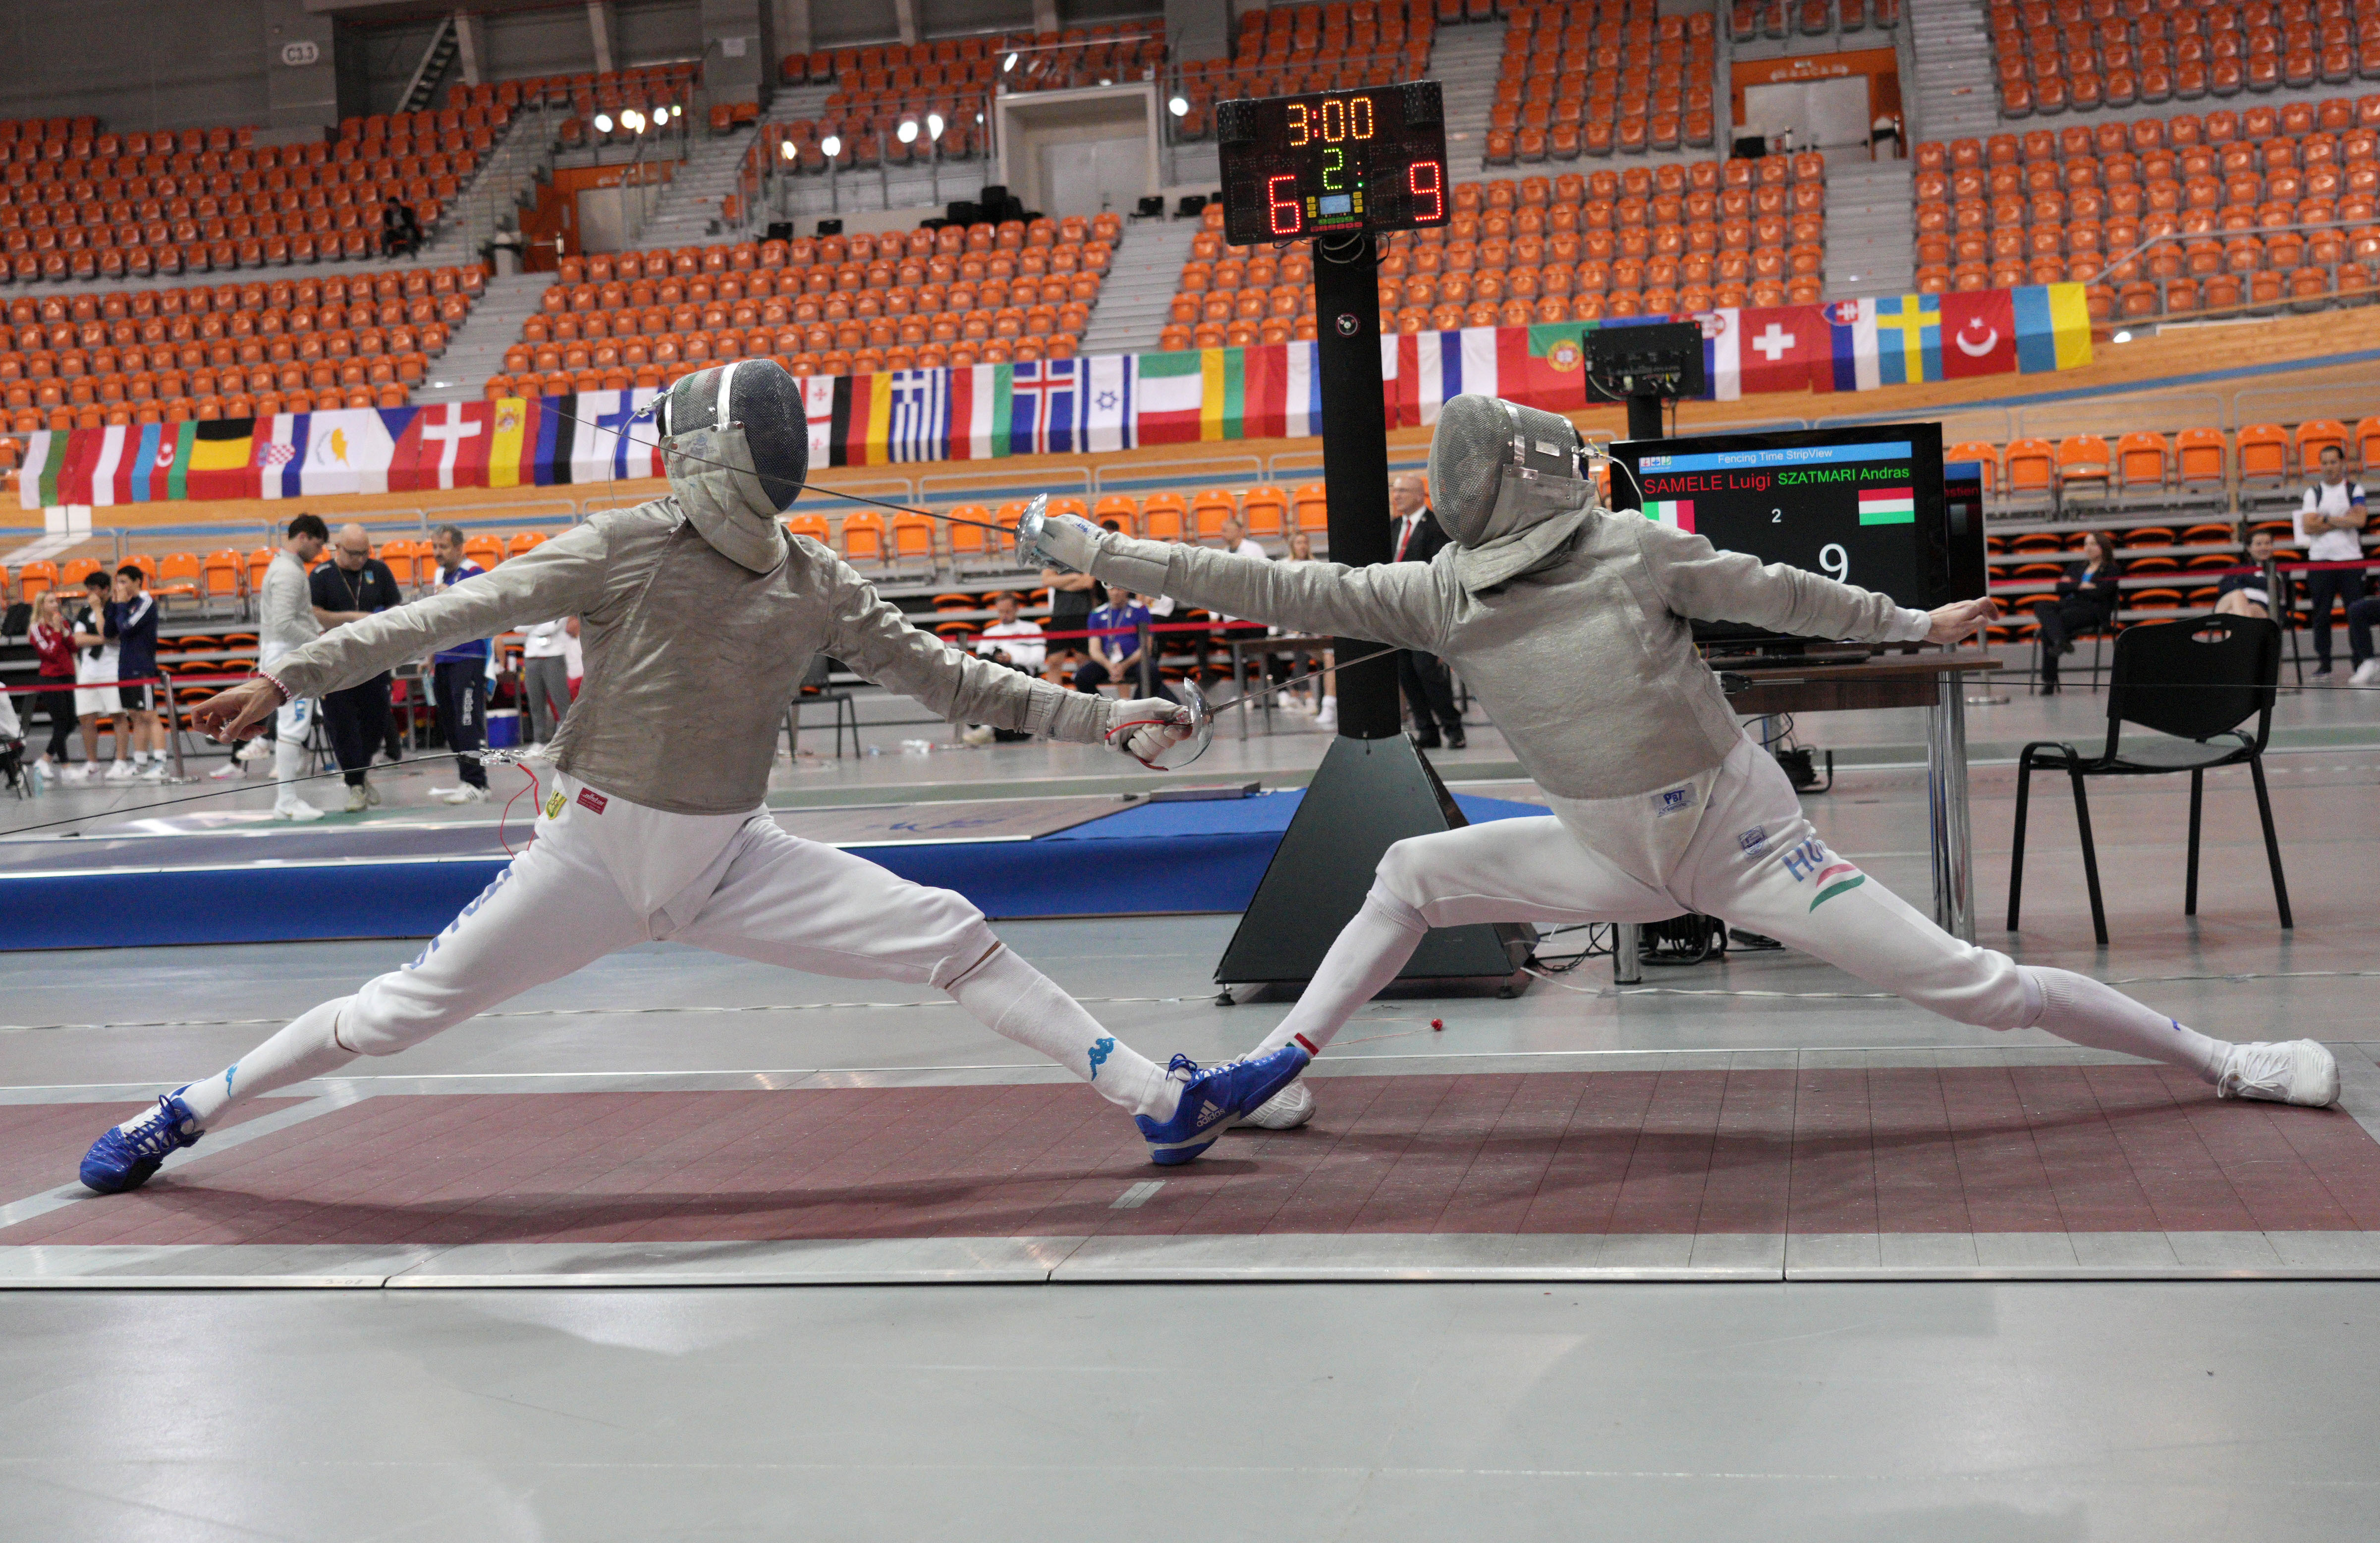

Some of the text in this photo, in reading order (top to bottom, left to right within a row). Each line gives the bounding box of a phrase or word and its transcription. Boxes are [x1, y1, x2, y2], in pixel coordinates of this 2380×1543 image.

[1287, 97, 1374, 146] 3:00
[1323, 148, 1343, 190] 2
[1409, 161, 1442, 222] 9
[1268, 174, 1300, 234] 6
[1717, 449, 1832, 464] Fencing Time StripView
[1644, 472, 1771, 494] SAMELE Luigi
[1778, 466, 1910, 485] SZATMARI Andras
[1771, 509, 1781, 523] 2
[1819, 543, 1848, 584] 9
[1663, 790, 1685, 804] PBT
[1197, 1108, 1225, 1127] adidas
